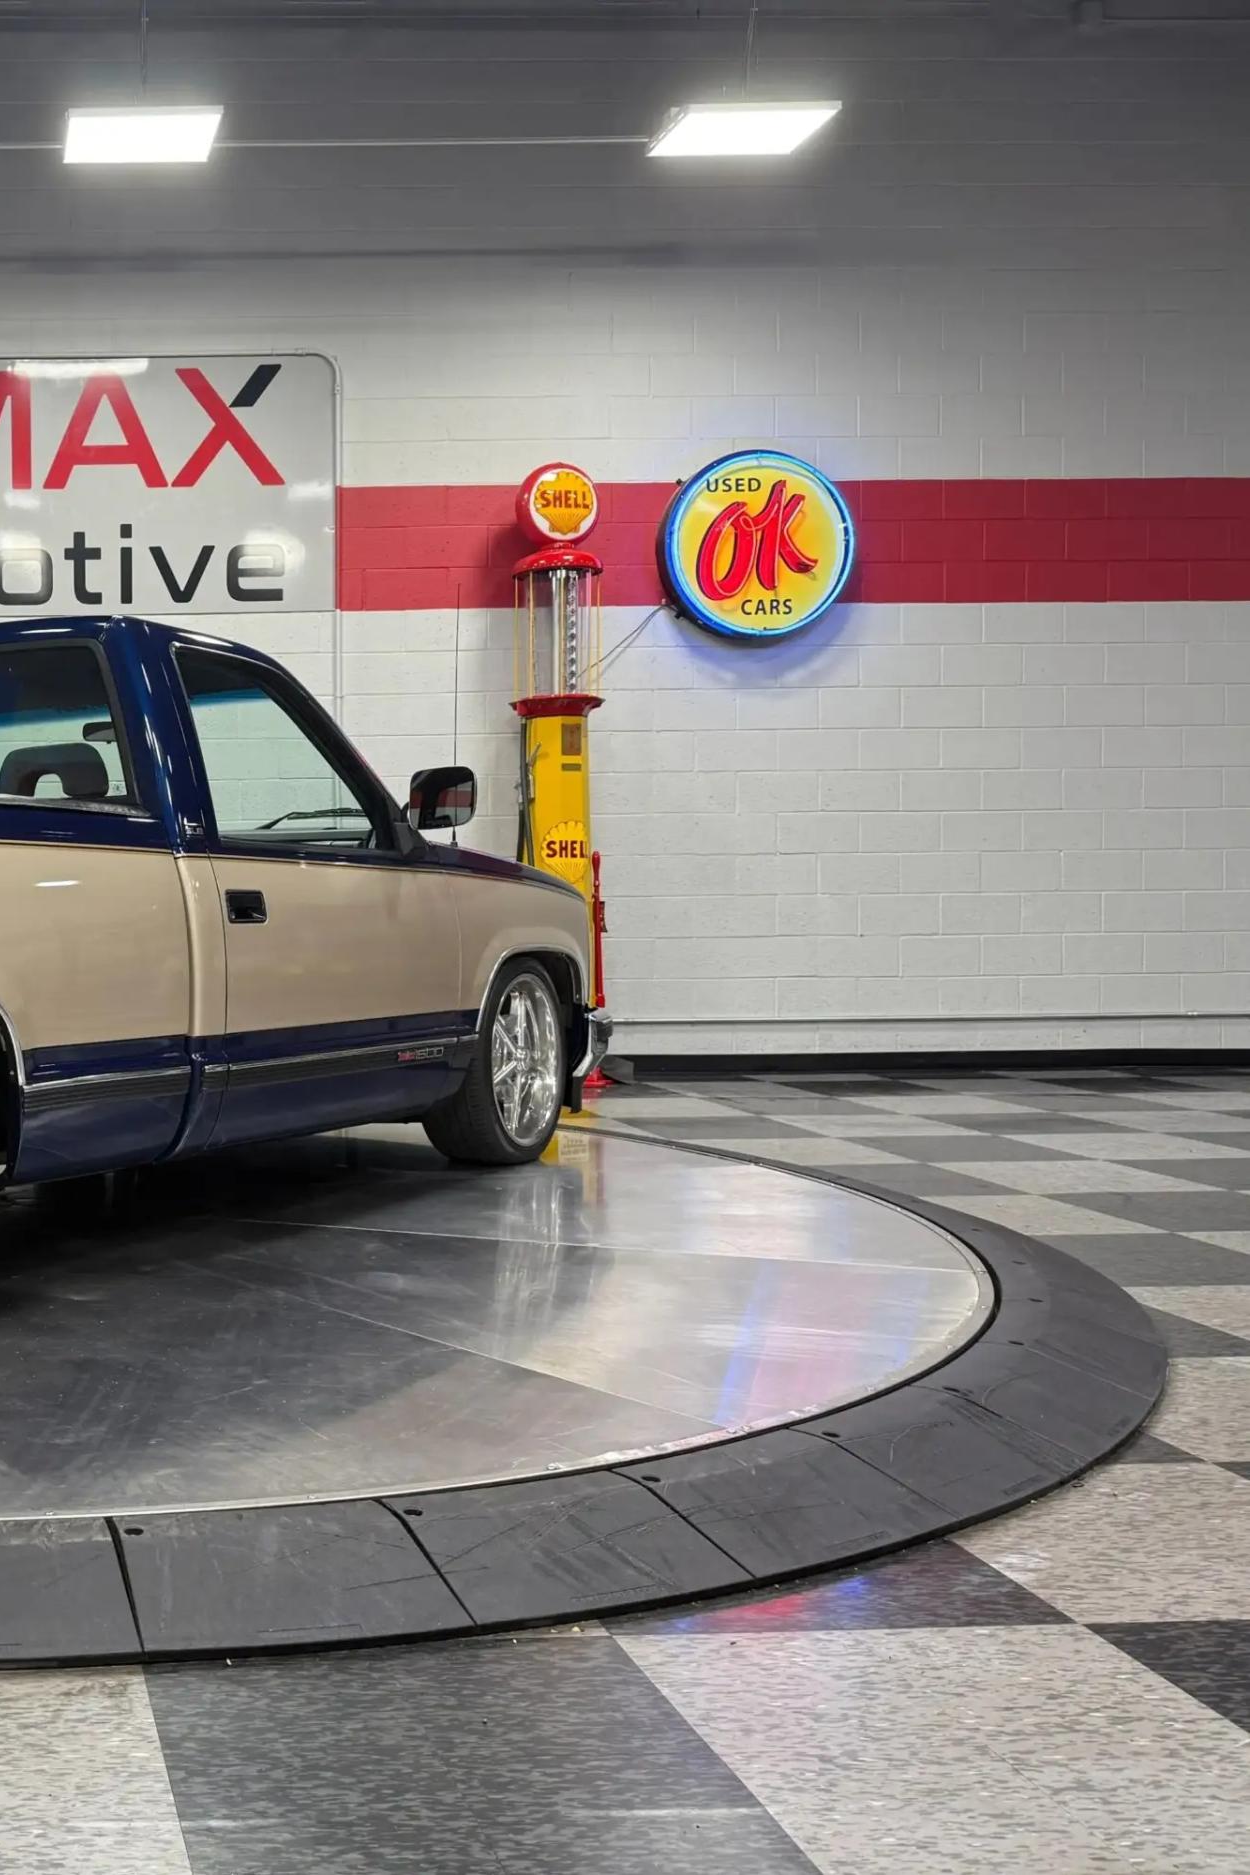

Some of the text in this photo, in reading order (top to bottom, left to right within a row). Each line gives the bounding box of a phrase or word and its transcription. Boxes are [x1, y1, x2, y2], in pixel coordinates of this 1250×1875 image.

[706, 478, 762, 492] USED
[540, 490, 590, 509] SHELL
[696, 480, 819, 600] OK
[741, 599, 793, 615] CARS
[545, 840, 588, 858] SHEL
